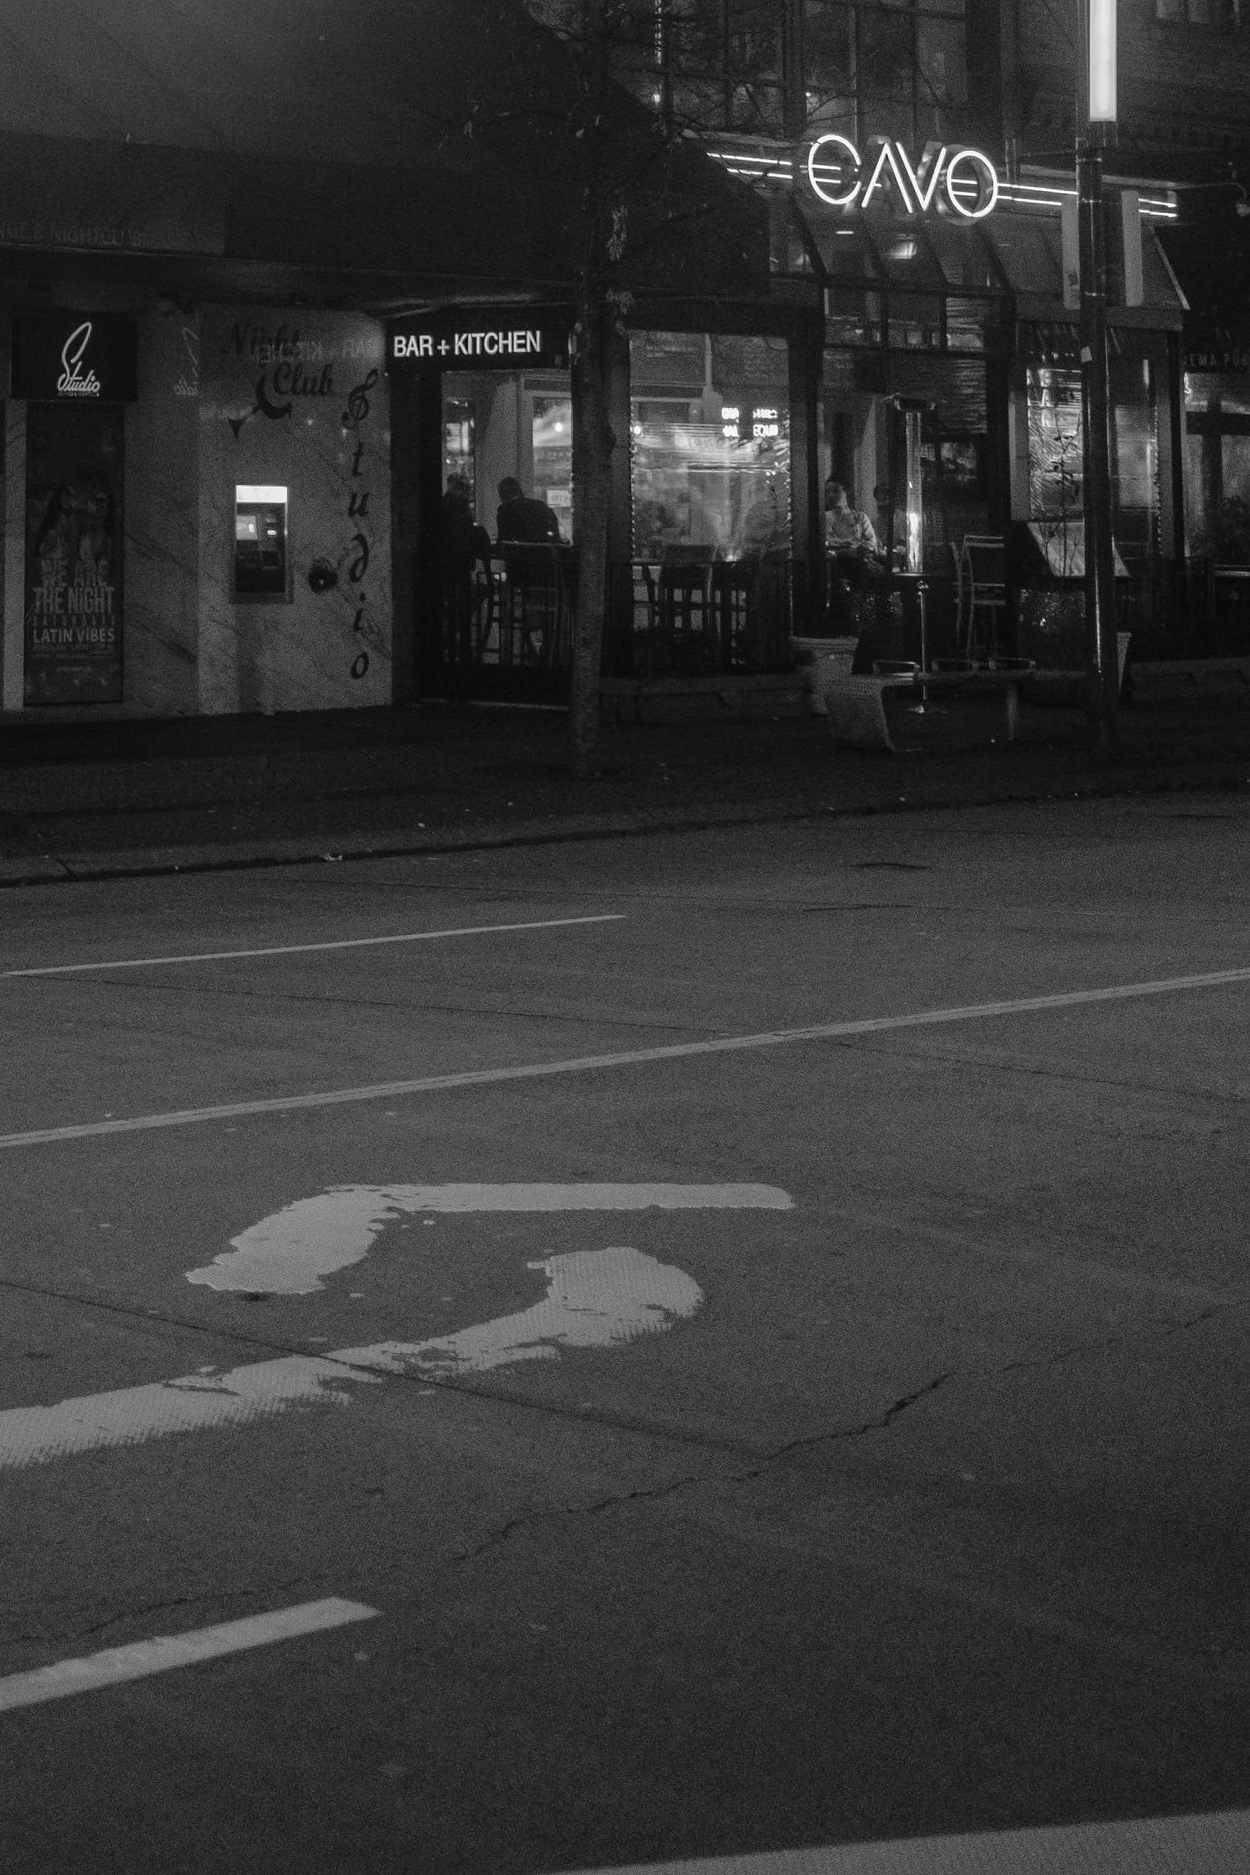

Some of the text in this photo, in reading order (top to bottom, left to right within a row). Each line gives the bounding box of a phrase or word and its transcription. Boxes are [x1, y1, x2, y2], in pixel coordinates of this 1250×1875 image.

[807, 133, 999, 219] CAVO
[57, 321, 101, 393] Studio
[393, 330, 541, 357] BAR + KITCHEN
[273, 361, 335, 396] Club
[33, 586, 116, 614] THE NIGHT
[33, 628, 116, 643] LATIN VIBES
